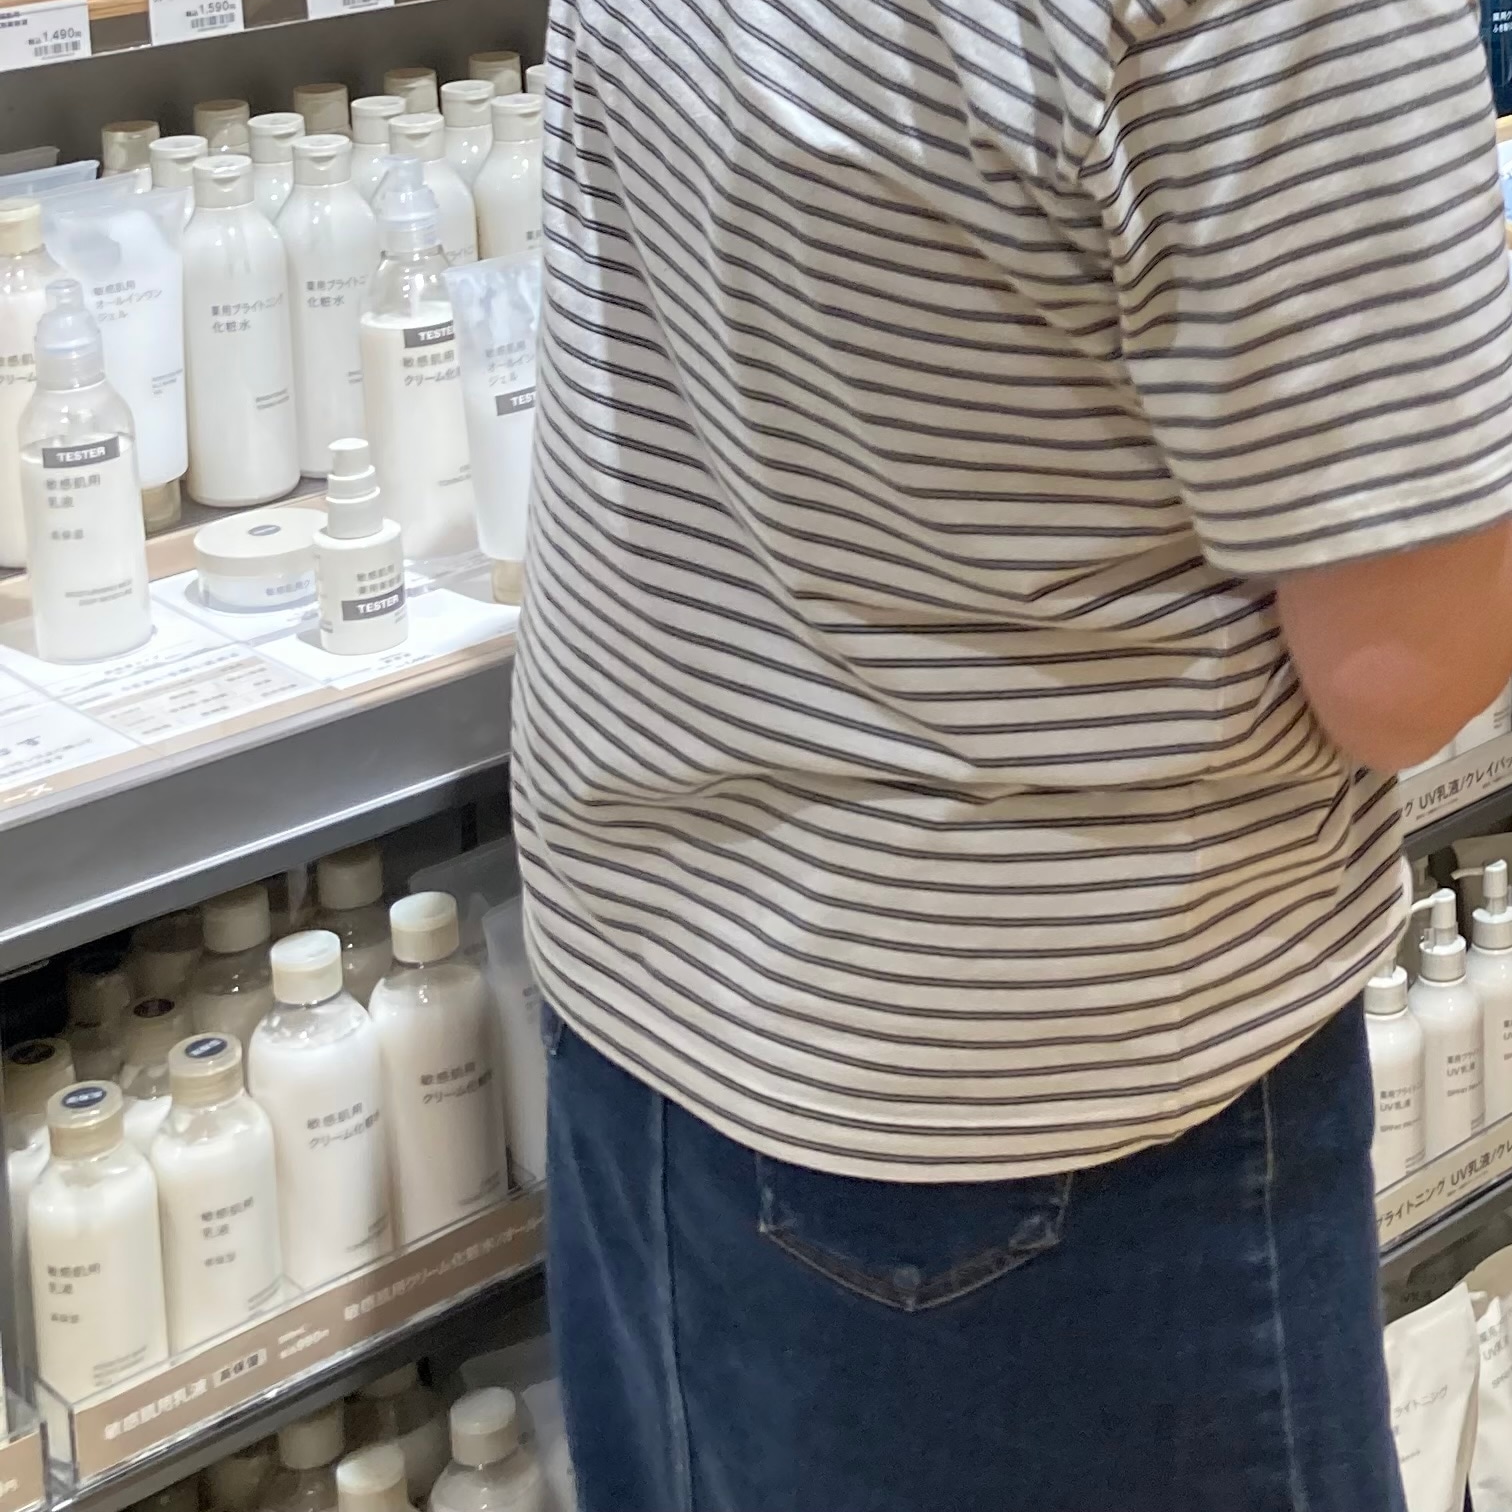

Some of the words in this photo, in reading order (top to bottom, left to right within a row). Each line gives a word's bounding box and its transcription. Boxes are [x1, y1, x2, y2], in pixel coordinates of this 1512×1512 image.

[307, 295, 345, 308] 化粧水
[212, 320, 251, 334] 化粧水
[56, 446, 106, 463] TESTER
[357, 594, 399, 615] TESTER
